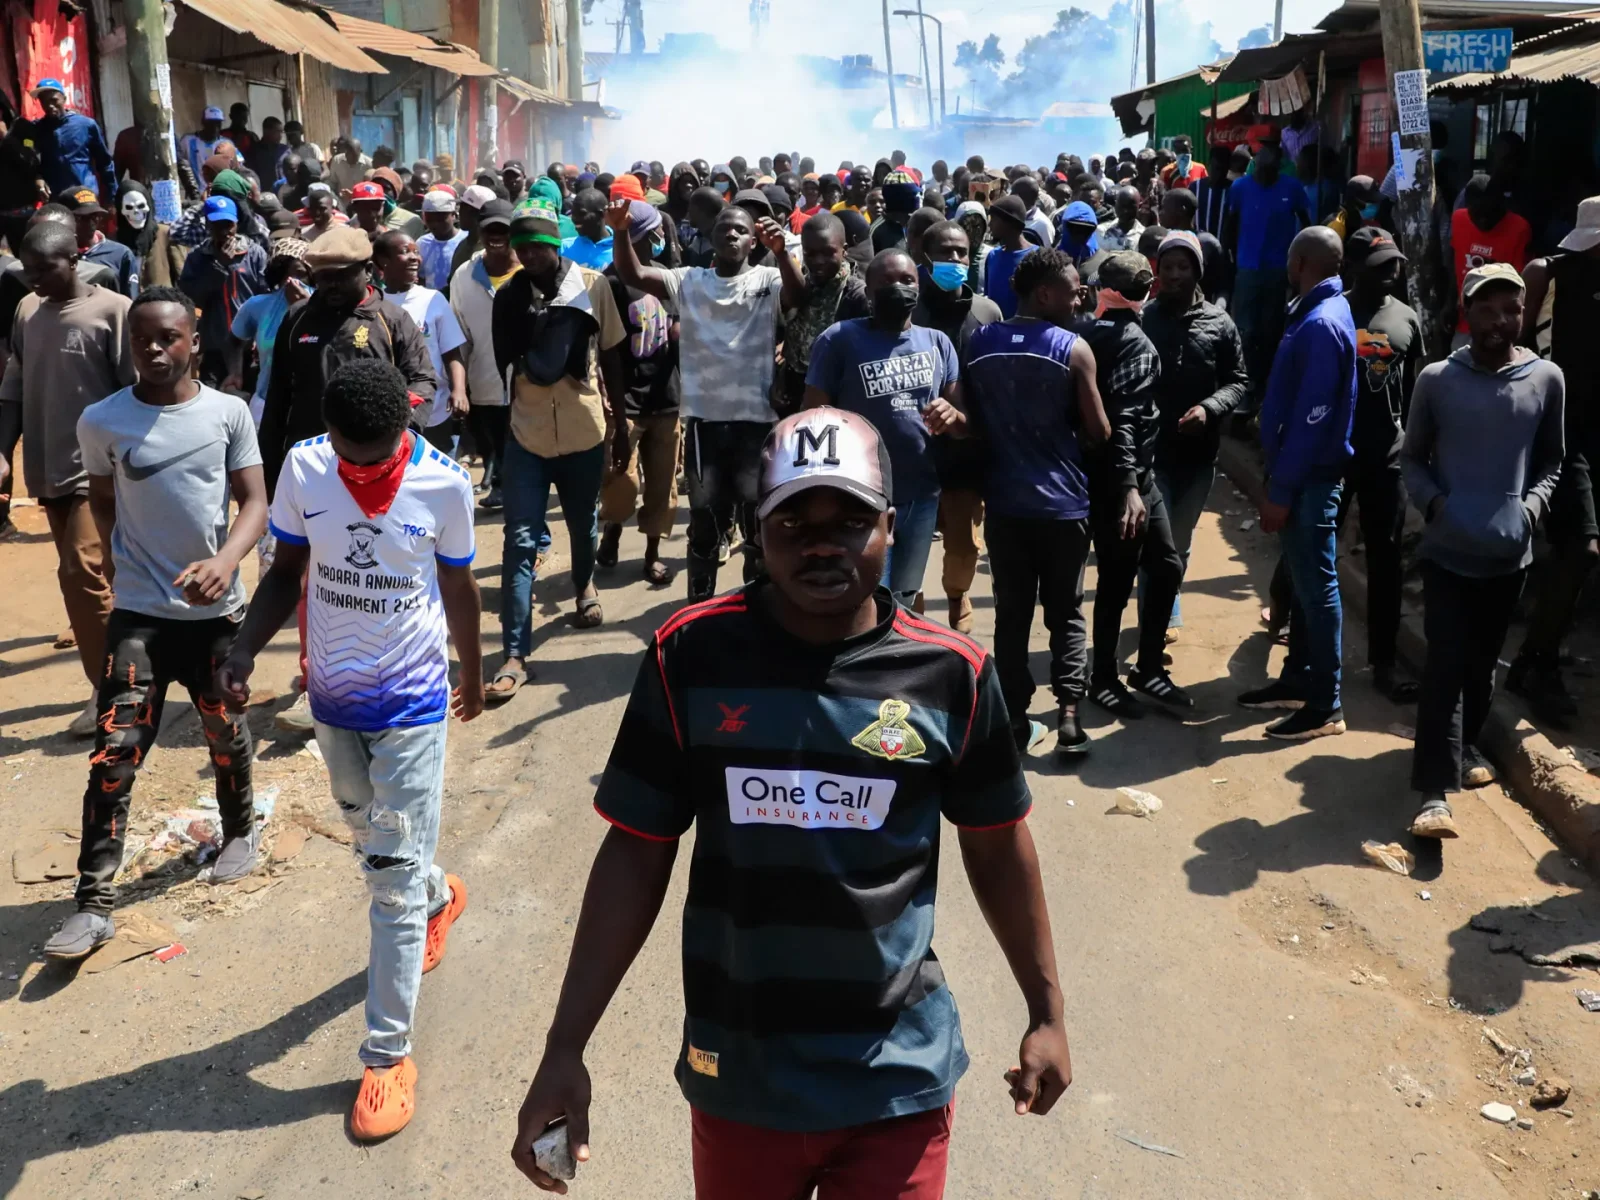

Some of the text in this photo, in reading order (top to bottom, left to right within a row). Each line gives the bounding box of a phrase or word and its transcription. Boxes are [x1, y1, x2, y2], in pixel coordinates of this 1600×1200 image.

[1427, 33, 1507, 58] FRESH
[1442, 55, 1495, 73] MILK
[863, 354, 931, 380] CERVEZA
[868, 368, 934, 396] POR FAVOR
[793, 424, 841, 467] M
[365, 573, 415, 590] ANNUAL
[741, 776, 873, 809] One Call
[746, 807, 868, 824] INSURANCE
